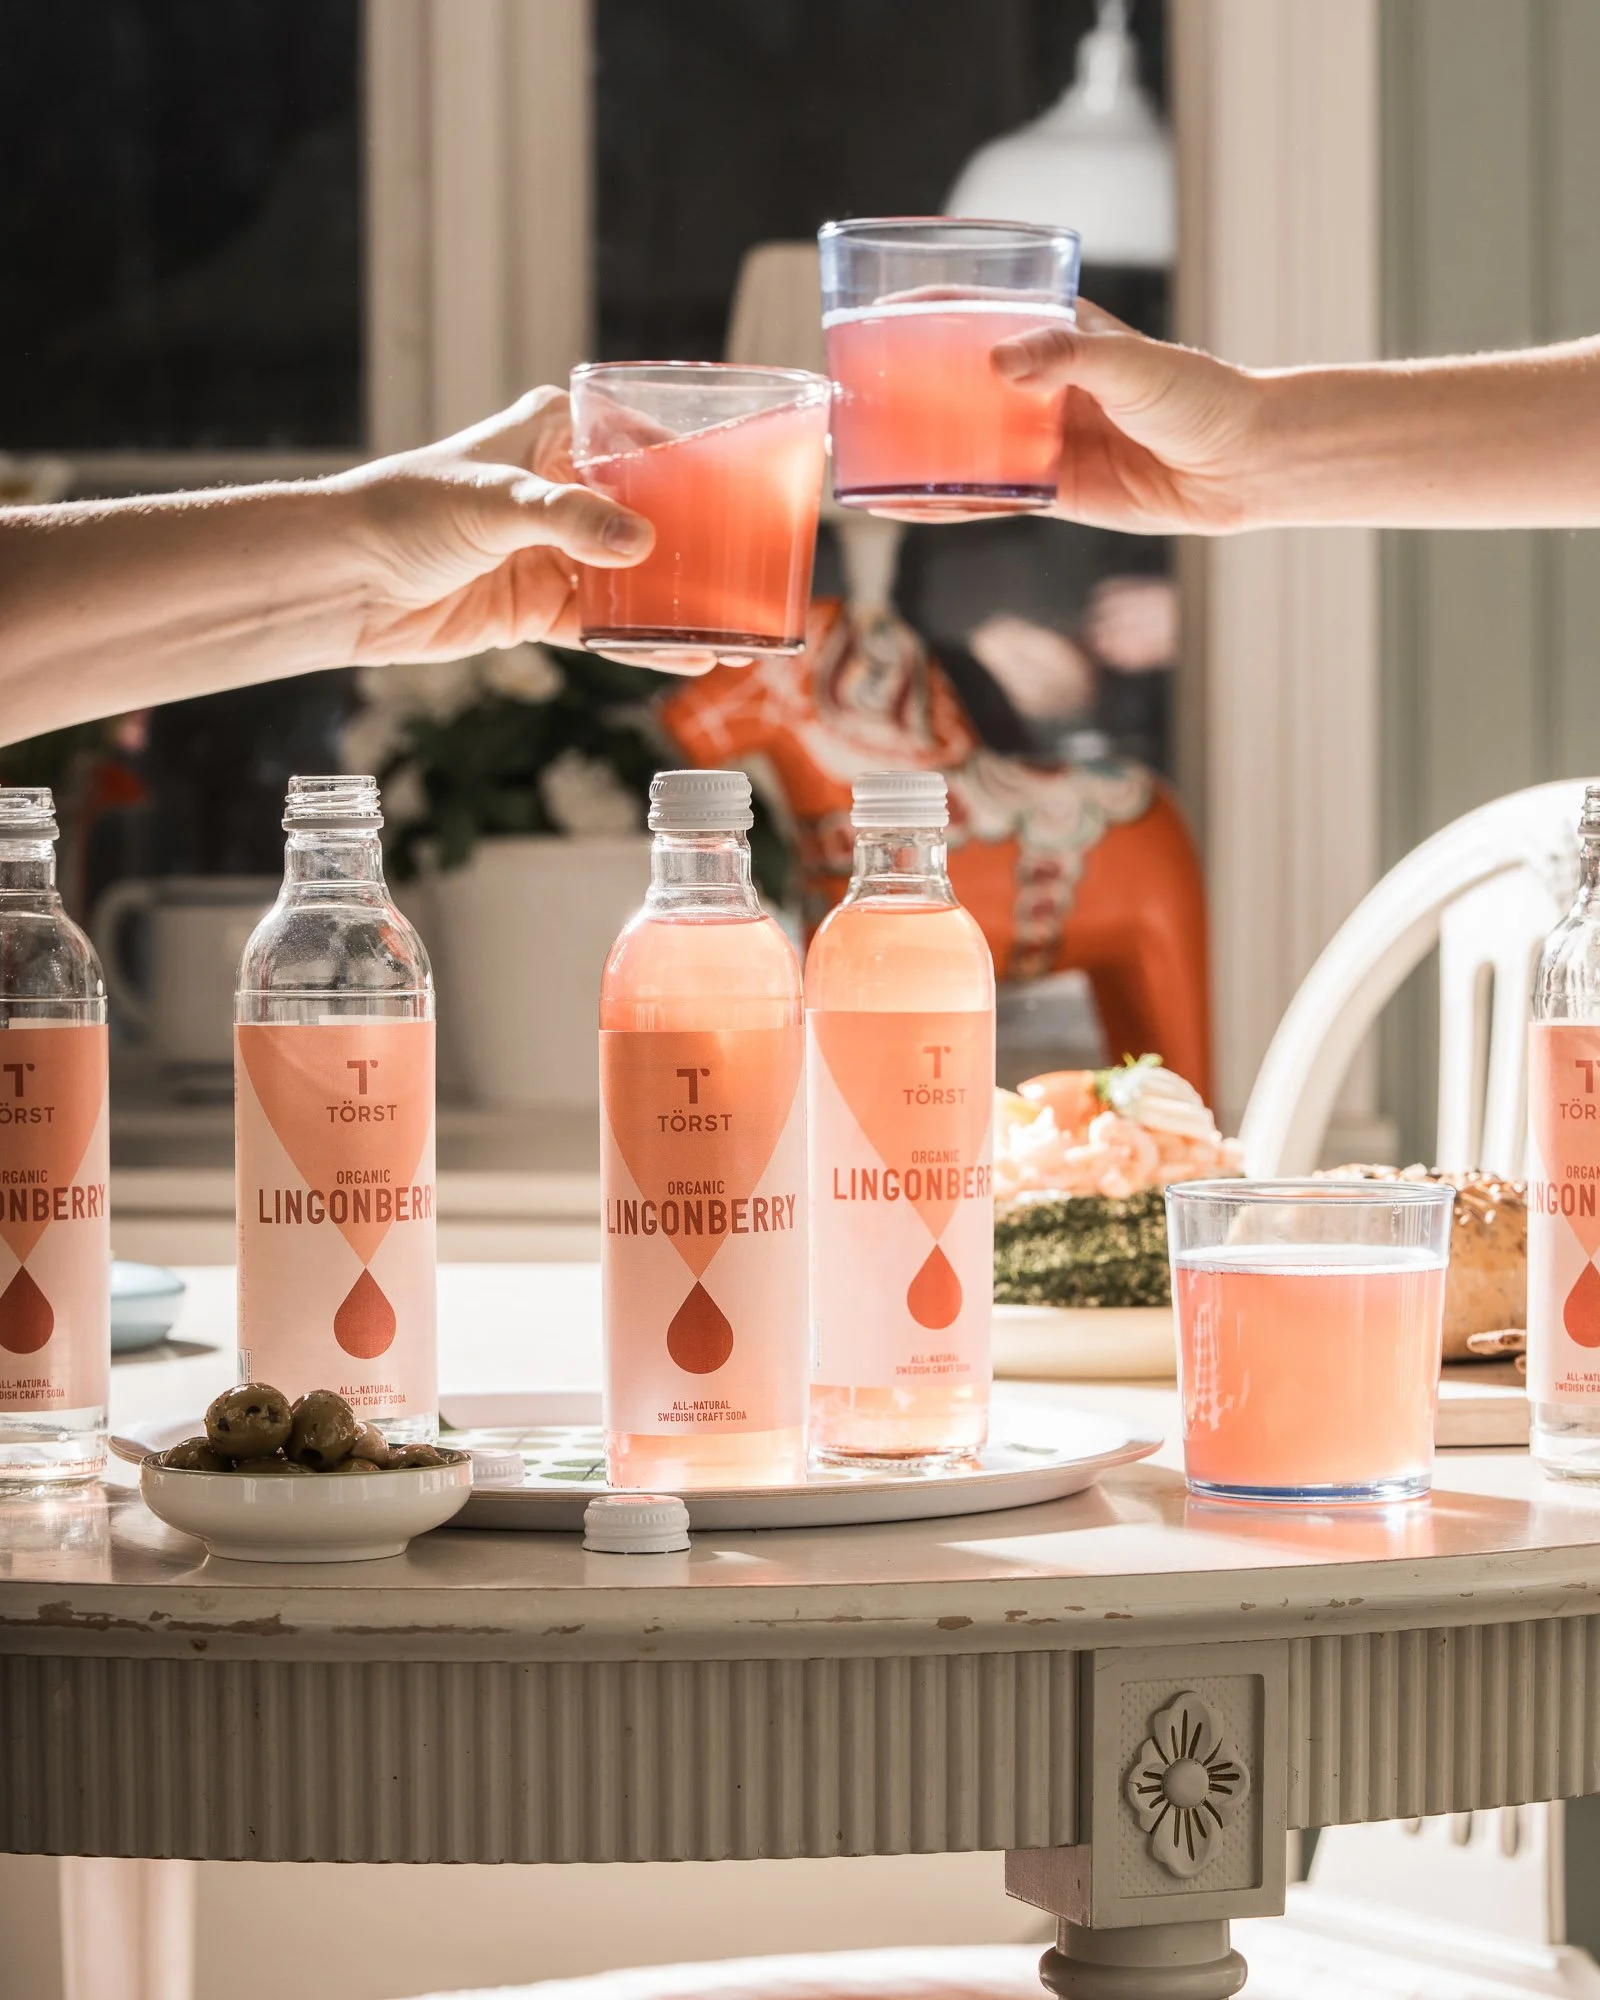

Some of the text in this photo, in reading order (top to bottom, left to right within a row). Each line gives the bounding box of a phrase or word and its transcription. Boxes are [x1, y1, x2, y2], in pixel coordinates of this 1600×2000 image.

[903, 1084, 966, 1105] TÖRST
[326, 1101, 397, 1122] TÖRST
[1559, 1098, 1600, 1120] TÖR
[657, 1109, 732, 1132] TÖRST
[911, 1150, 960, 1164] ORGANIC
[336, 1169, 390, 1184] ORGANIC
[667, 1180, 725, 1195] ORGANIC
[258, 1184, 434, 1224] LINGONBERR
[607, 1194, 796, 1236] LINGONBERRY
[0, 1379, 51, 1388] LL-NATURAL
[340, 1384, 393, 1395] ALL-NATURAL
[20, 1390, 44, 1399] CRAFT
[363, 1396, 387, 1405] CRAFT
[672, 1400, 731, 1411] ALL-NATURAL
[657, 1411, 747, 1422] SWEDISH CRAFT SODA
